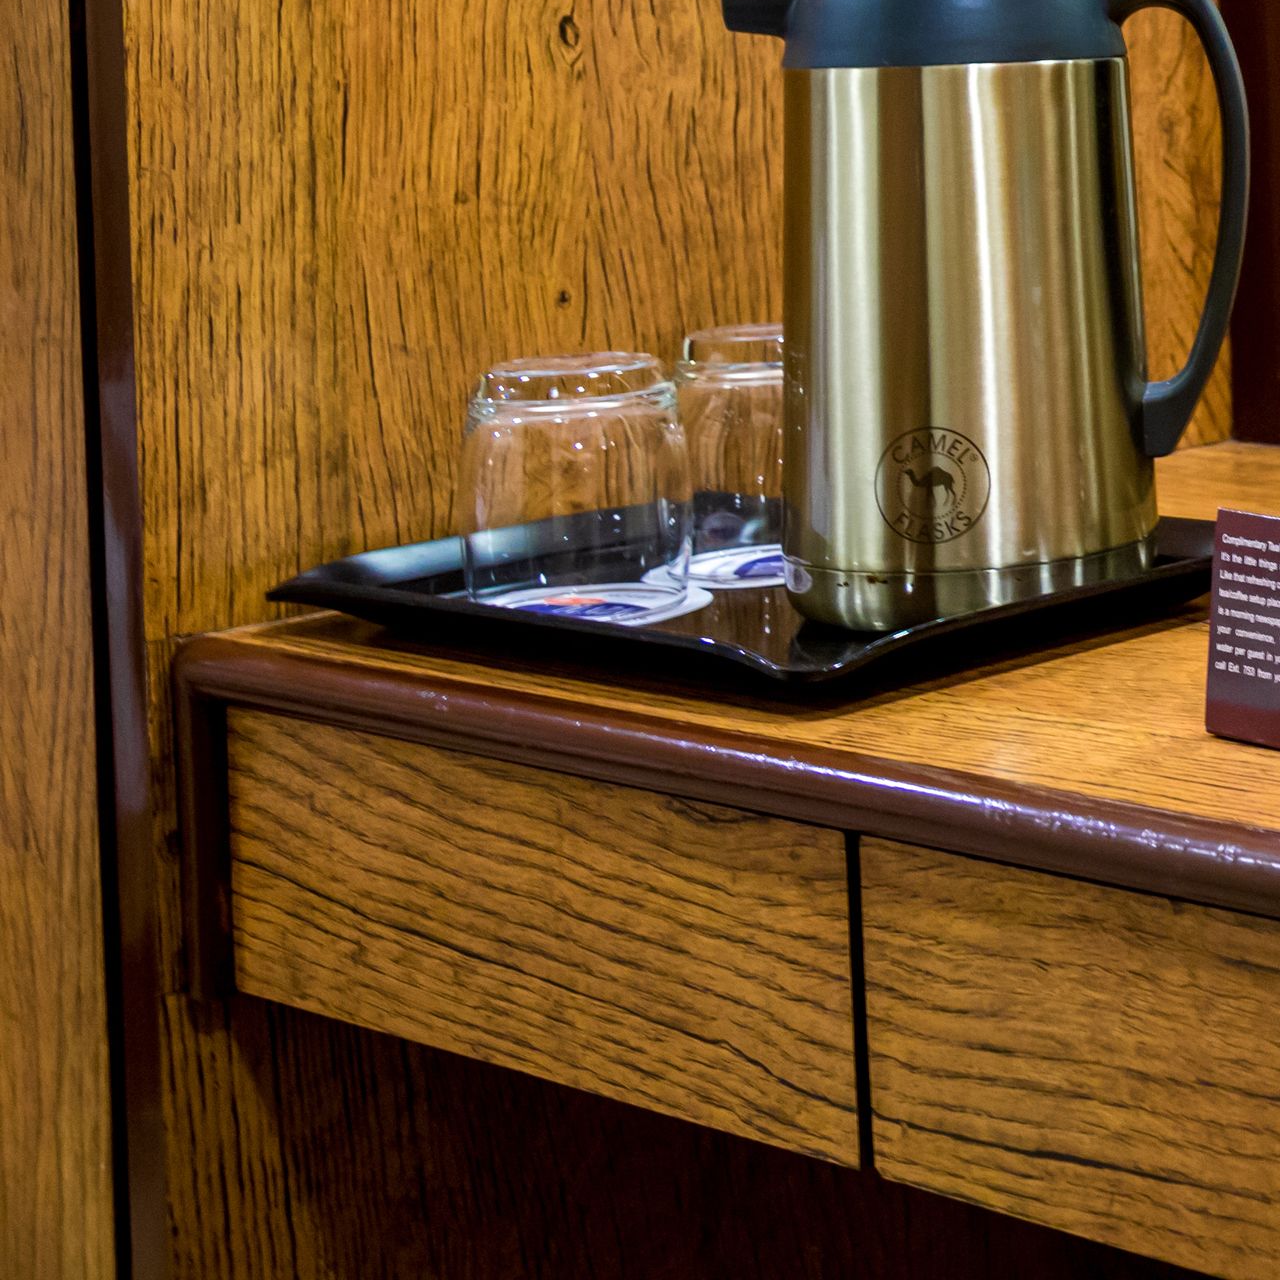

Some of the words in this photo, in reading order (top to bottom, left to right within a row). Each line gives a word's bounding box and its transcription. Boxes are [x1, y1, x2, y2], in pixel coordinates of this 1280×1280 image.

[892, 432, 970, 464] CAMEL
[894, 511, 972, 540] FLASKS
[1232, 554, 1243, 564] the
[1259, 559, 1278, 572] things
[1220, 570, 1232, 580] Like
[1246, 575, 1276, 591] refreshing
[1218, 605, 1225, 615] is
[1225, 608, 1230, 616] a
[1230, 610, 1255, 623] morning
[1217, 625, 1232, 635] your
[1216, 643, 1234, 653] water
[1234, 647, 1246, 657] per
[1247, 650, 1265, 660] guest
[1266, 651, 1274, 662] in
[1215, 661, 1227, 671] call
[1257, 668, 1273, 680] from
